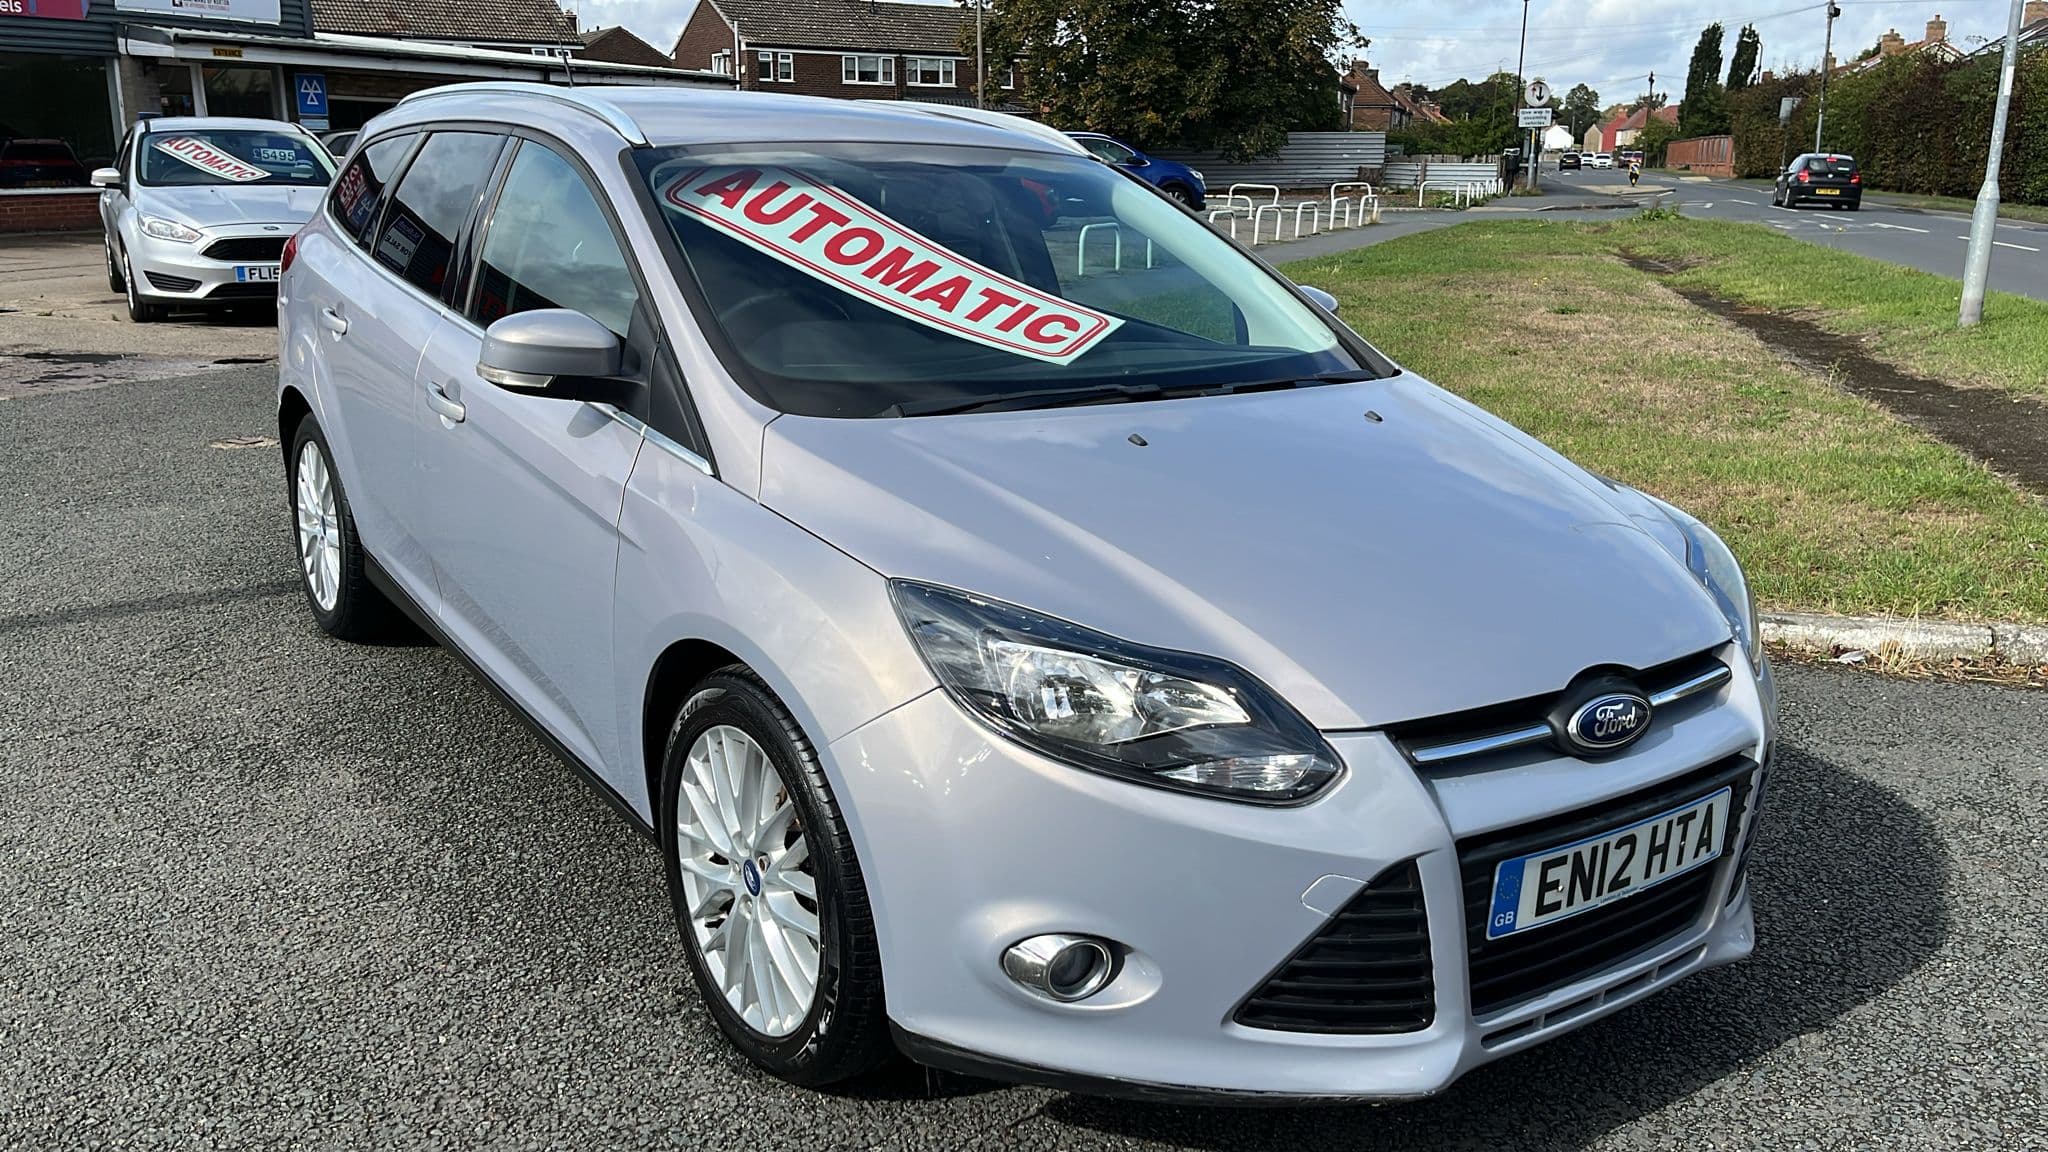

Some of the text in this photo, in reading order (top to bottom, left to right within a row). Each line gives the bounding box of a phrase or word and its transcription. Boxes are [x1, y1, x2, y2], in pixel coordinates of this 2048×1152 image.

[165, 138, 256, 178] AUTOMATIC
[695, 168, 1081, 344] AUTOMATIC
[1594, 702, 1638, 737] Ford
[1535, 803, 1714, 917] EN12 HTA
[1494, 911, 1514, 928] GB
